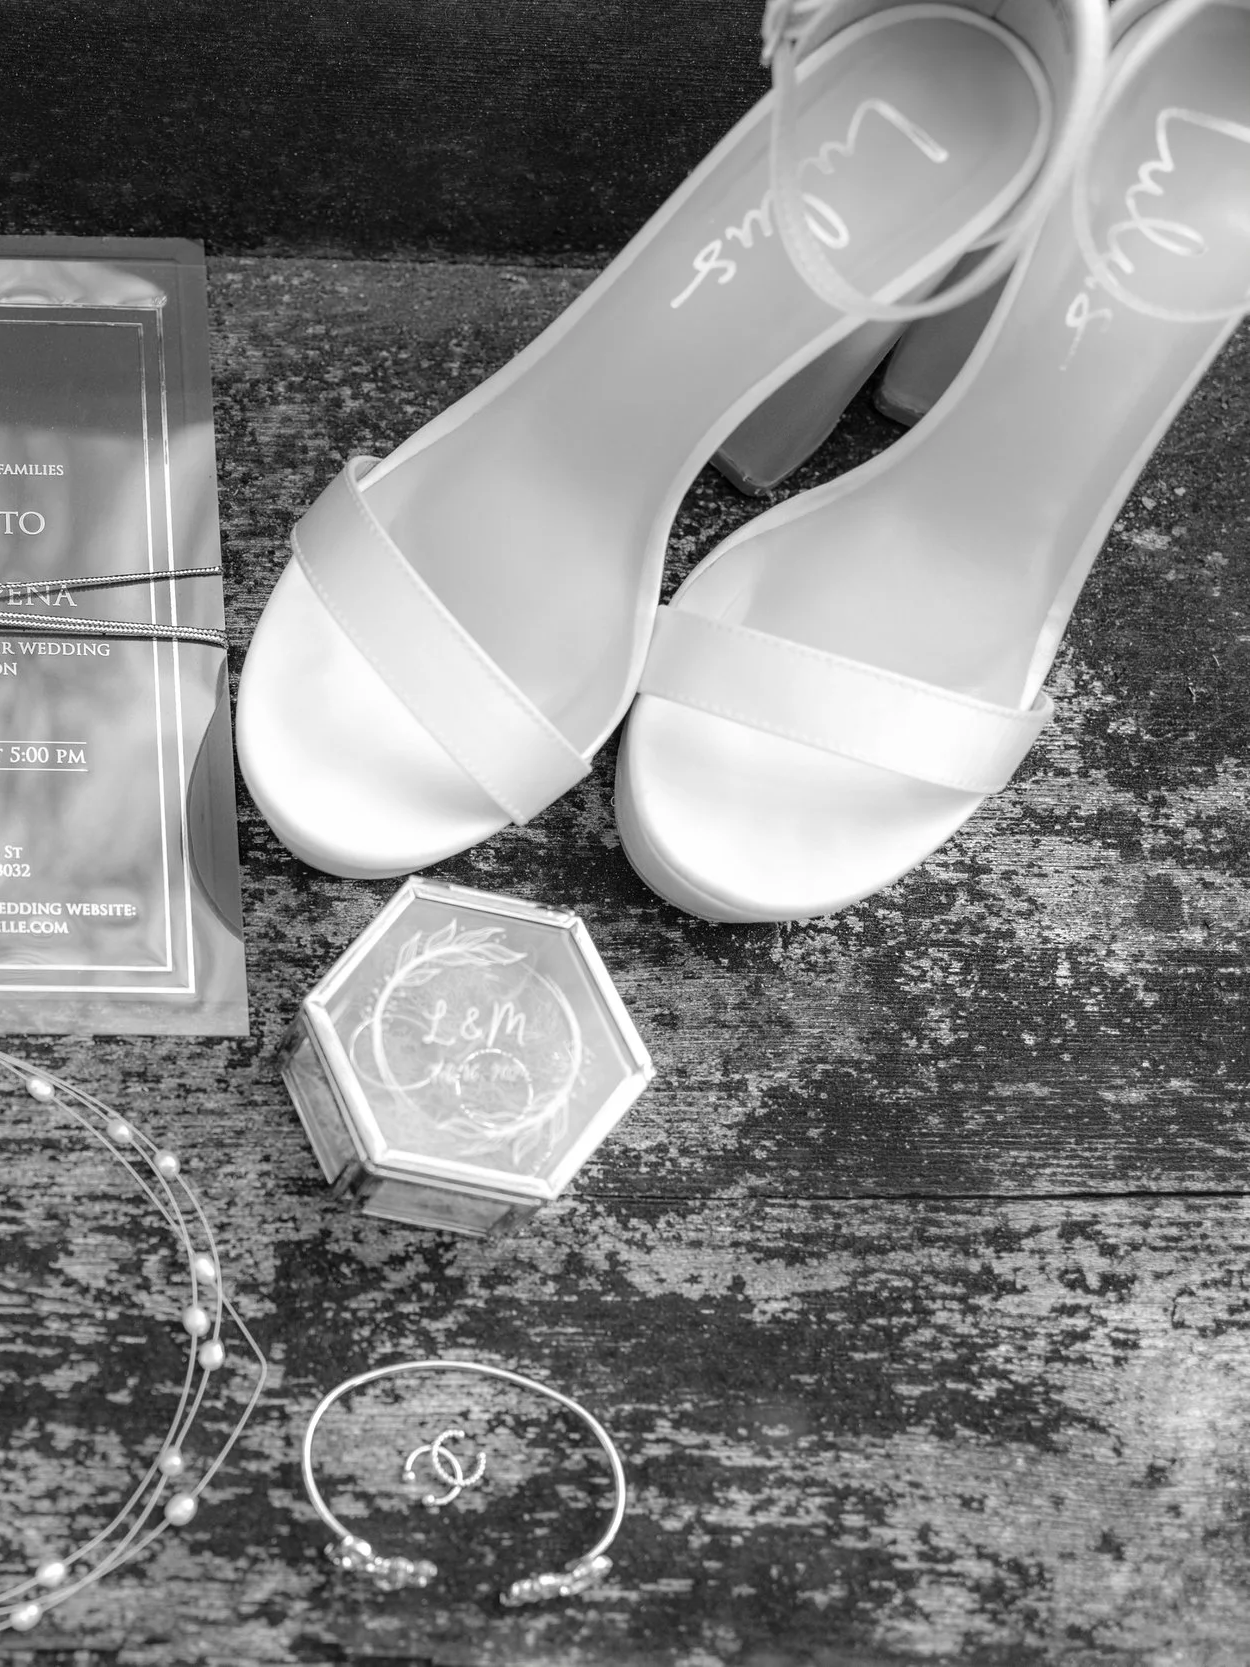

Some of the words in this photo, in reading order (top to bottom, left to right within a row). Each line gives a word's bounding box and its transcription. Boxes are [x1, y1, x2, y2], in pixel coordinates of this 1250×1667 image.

[17, 642, 111, 657] WEDDING
[9, 745, 50, 764] 5:00
[55, 748, 88, 764] PM
[65, 903, 137, 917] WEBSITE:
